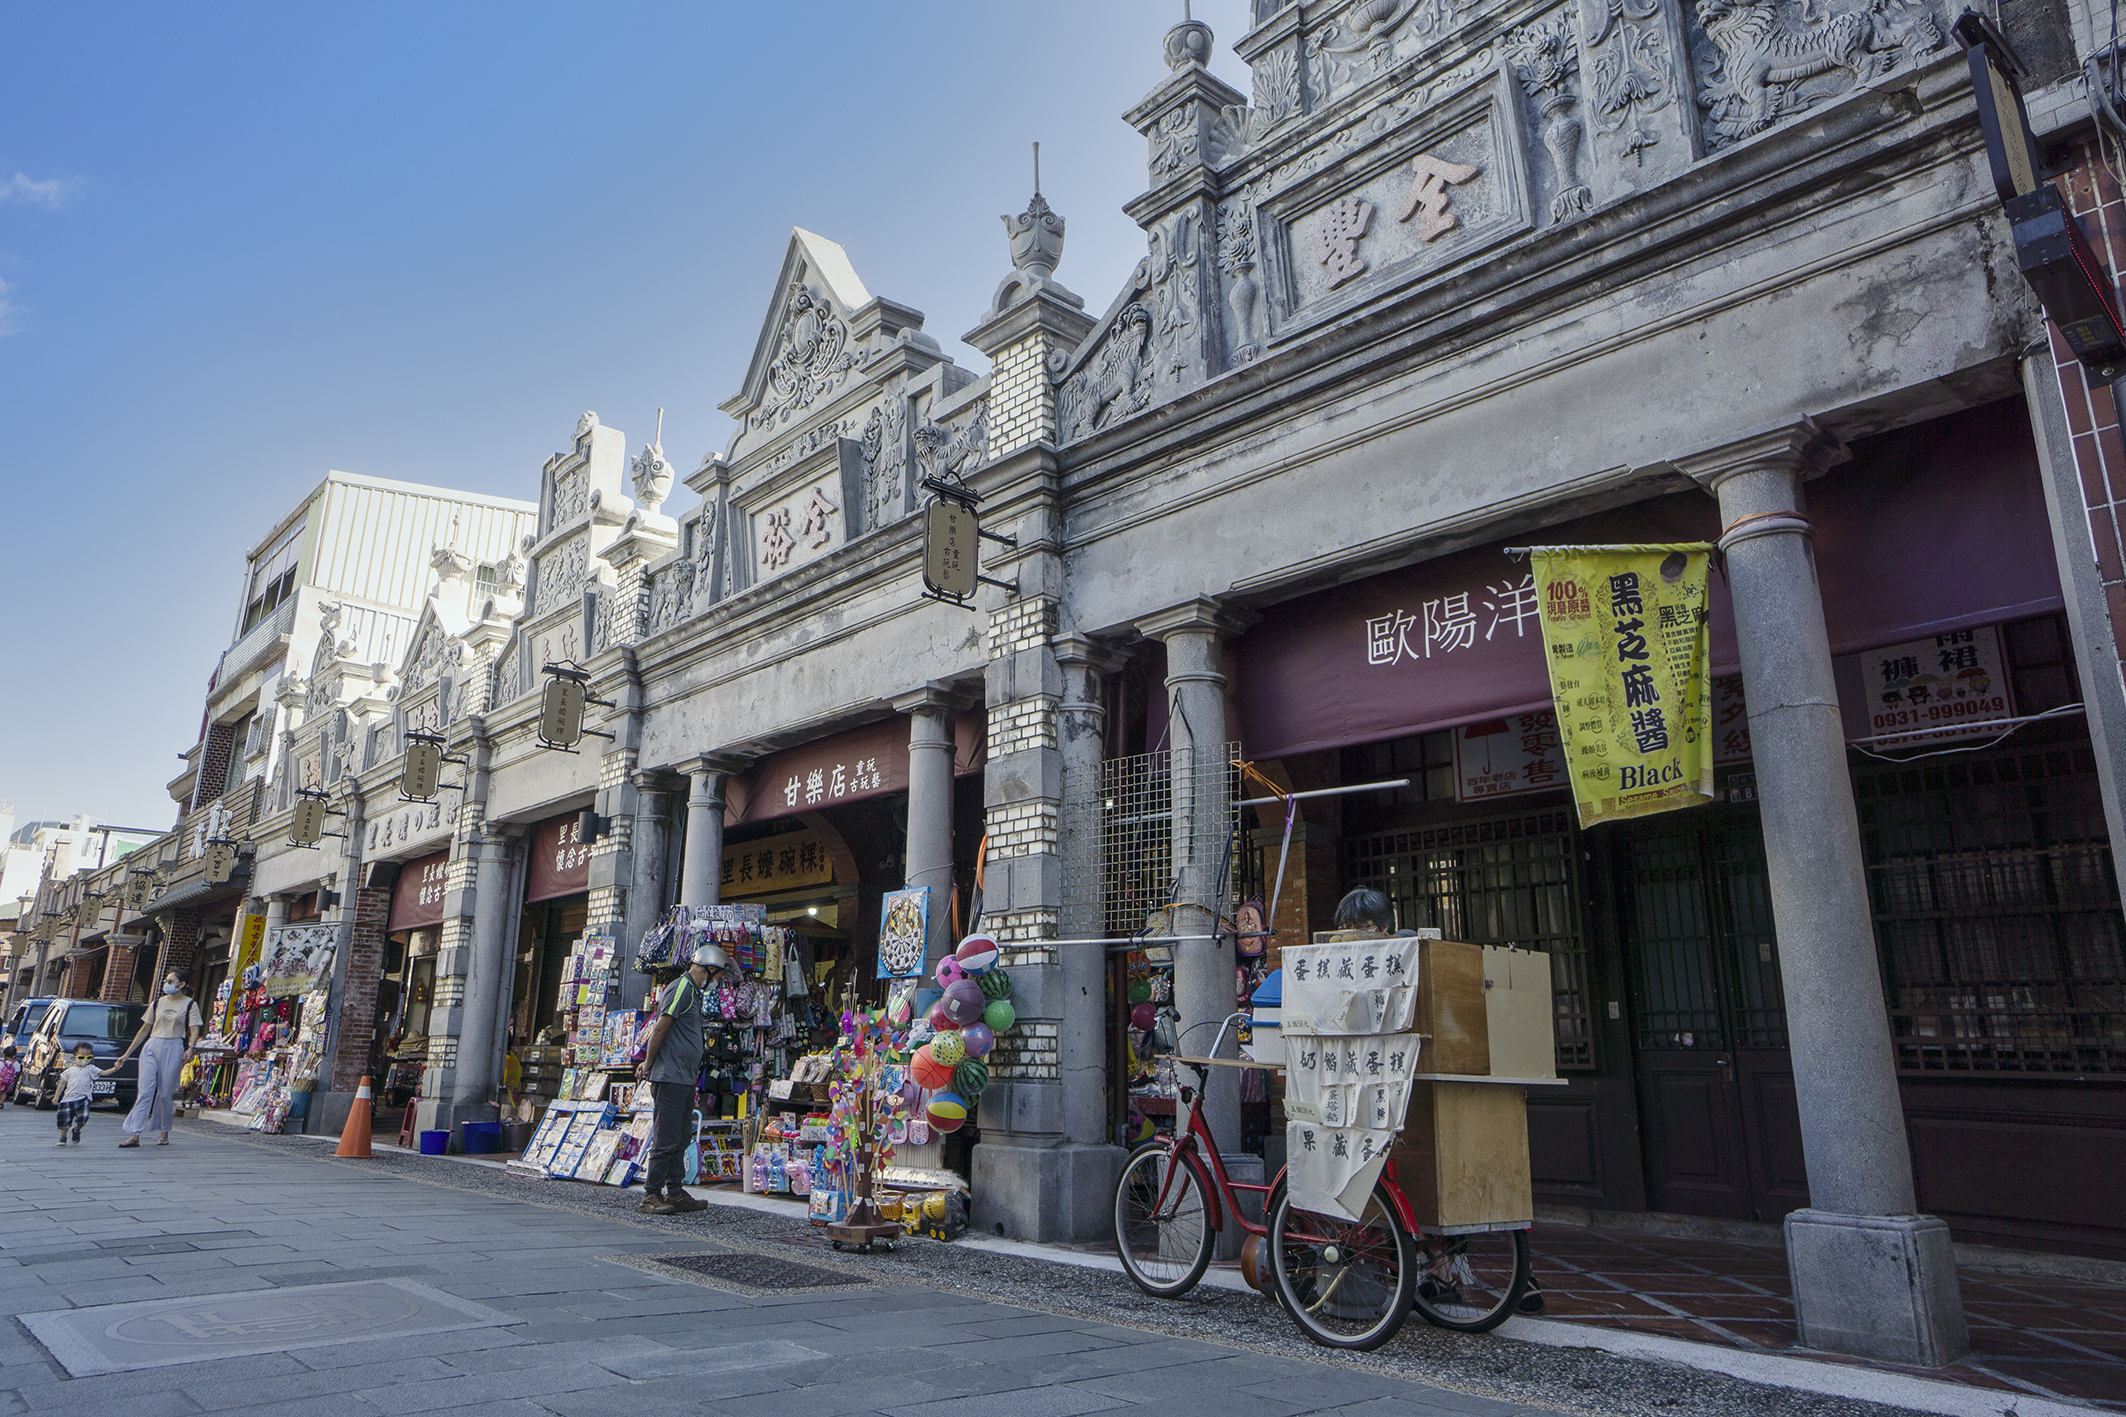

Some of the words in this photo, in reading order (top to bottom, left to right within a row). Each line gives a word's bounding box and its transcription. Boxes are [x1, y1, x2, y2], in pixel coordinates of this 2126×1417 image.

[947, 513, 958, 547] 甘樂店
[1547, 580, 1589, 600] 100%
[1365, 573, 1540, 666] 歐陽洋
[1547, 598, 1591, 615] 現磨原醬
[1569, 613, 1592, 621] Ground
[1609, 572, 1668, 754] 黑芝麻醬
[1873, 696, 2005, 730] 0931-999049
[855, 757, 877, 777] 童玩
[1466, 771, 1516, 787] 百年老店
[1619, 756, 1684, 791] Black
[783, 763, 846, 807] 甘樂店
[850, 771, 882, 794] 古玩藝
[1473, 782, 1512, 795] 專賣店
[1620, 792, 1658, 805] Sesame
[720, 841, 818, 886] 里長嬤碗粿
[1294, 953, 1405, 982] 蛋糕藏蛋糕
[1299, 1050, 1406, 1077] 奶餡藏蛋糕
